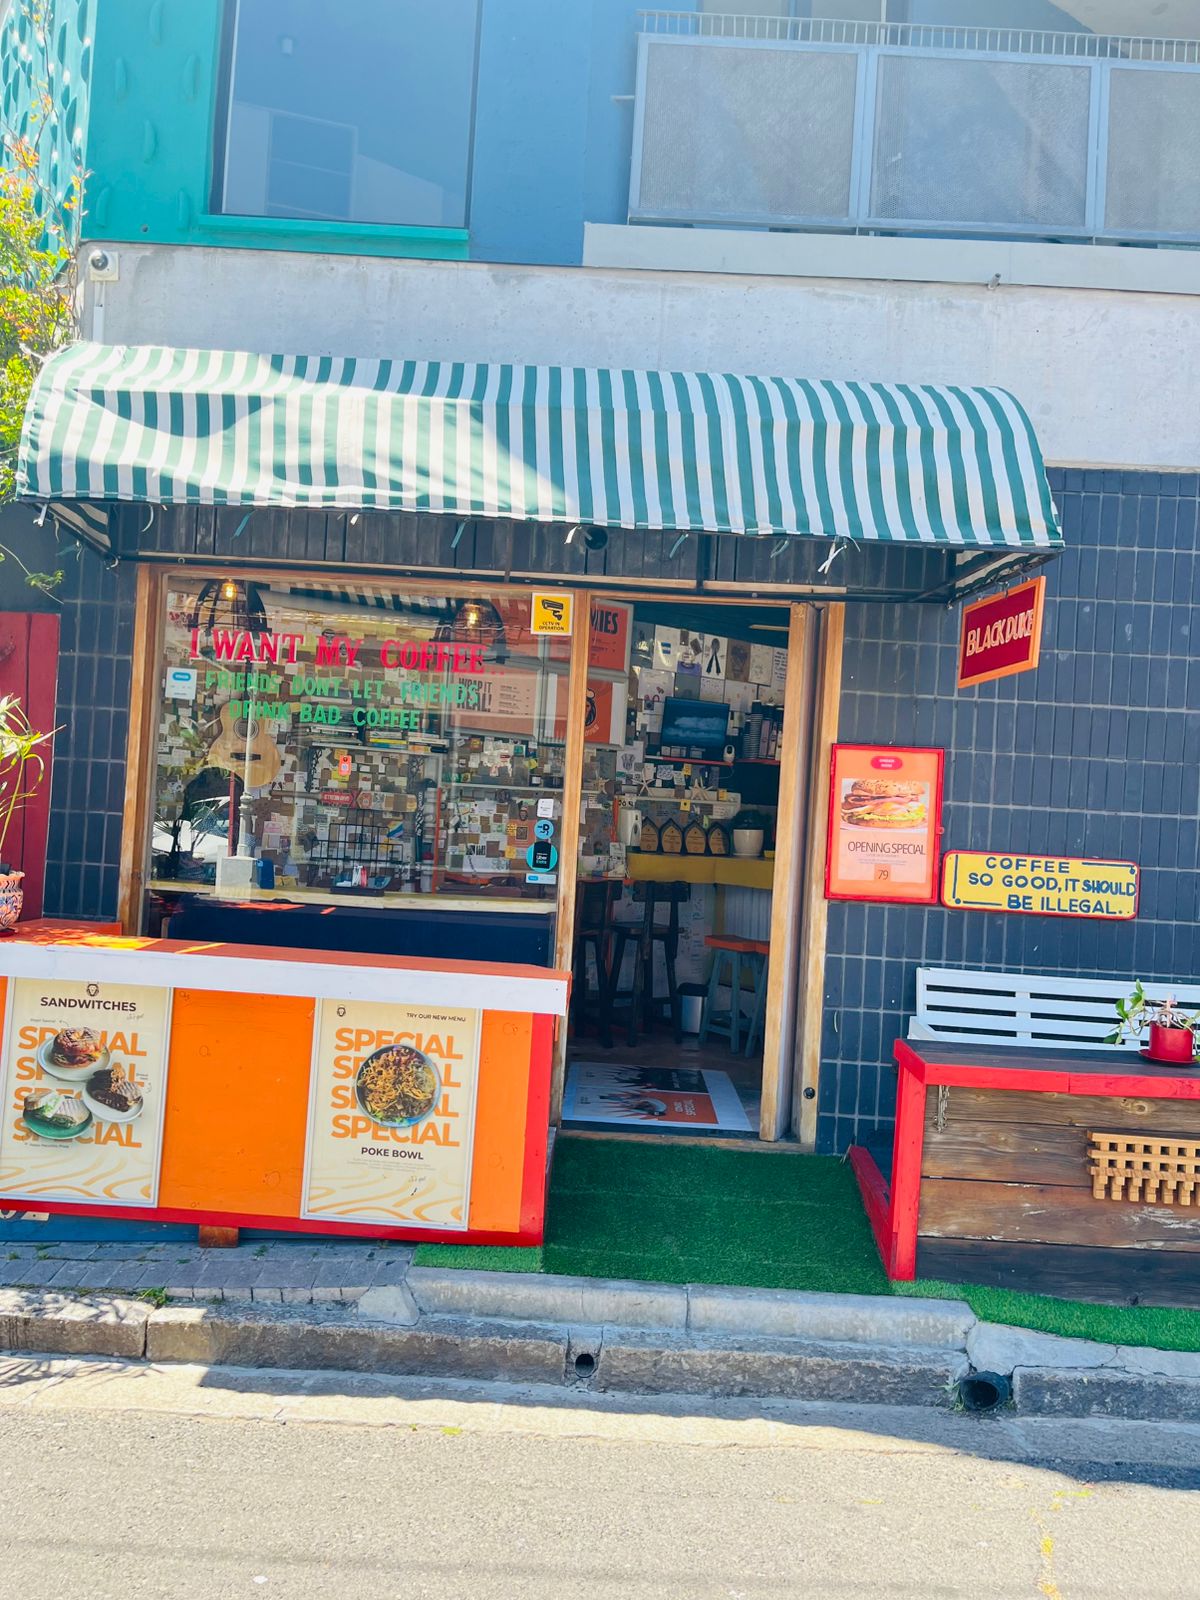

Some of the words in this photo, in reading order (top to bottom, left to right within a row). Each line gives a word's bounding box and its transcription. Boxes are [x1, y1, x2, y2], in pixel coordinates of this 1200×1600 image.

[966, 619, 1006, 657] BLACK
[1005, 609, 1034, 643] DUKE
[189, 628, 201, 661] I
[212, 629, 304, 664] WANT
[315, 636, 364, 667] MY
[205, 671, 284, 694] FRIENDS
[292, 675, 344, 698] DONT
[353, 679, 385, 700] LET
[401, 681, 480, 705] FRIENDS
[299, 703, 342, 725] BAD
[353, 707, 422, 730] COFFEE
[848, 841, 891, 854] OPENING
[891, 843, 926, 855] SPECIAL
[878, 870, 889, 880] 79
[986, 857, 1070, 874] COFFEE
[968, 872, 993, 886] SO
[1002, 875, 1062, 893] GOOD,
[1065, 878, 1080, 892] IT
[1081, 880, 1136, 897] SHOULD
[1007, 894, 1033, 910] BE
[1040, 896, 1123, 915] ILLEGAL.
[40, 996, 136, 1012] SANDWITCHES
[18, 1025, 147, 1056] SPIAL
[335, 1027, 463, 1060] SPECIAL
[331, 1114, 460, 1147] SPECIAL
[361, 1147, 389, 1157] POKE
[392, 1150, 424, 1160] BOWL
